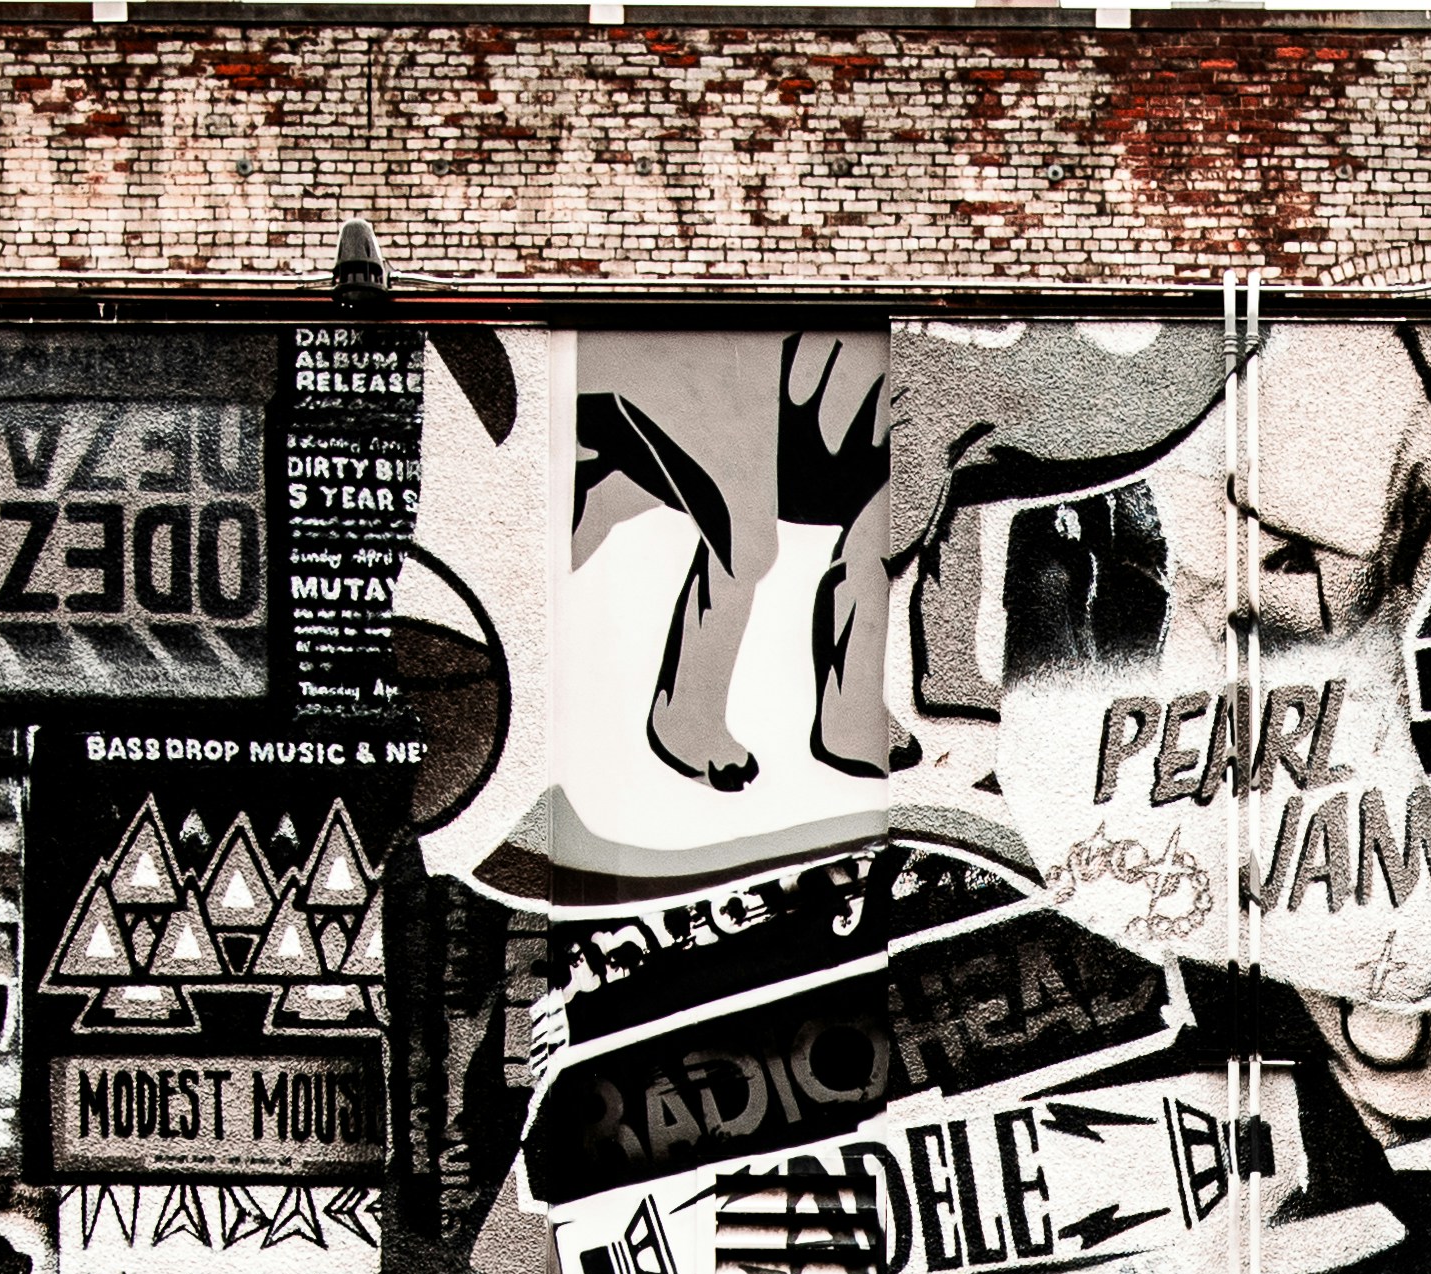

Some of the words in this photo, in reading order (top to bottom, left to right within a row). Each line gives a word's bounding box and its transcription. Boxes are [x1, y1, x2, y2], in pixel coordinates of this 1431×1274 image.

[295, 350, 398, 370] ALBUM
[295, 370, 422, 393] RELEASE
[287, 456, 369, 479] DIRTY
[249, 740, 345, 765] MUSIC
[356, 742, 376, 764] &
[1094, 679, 1356, 807] PEARL
[78, 1069, 232, 1142] MODEST
